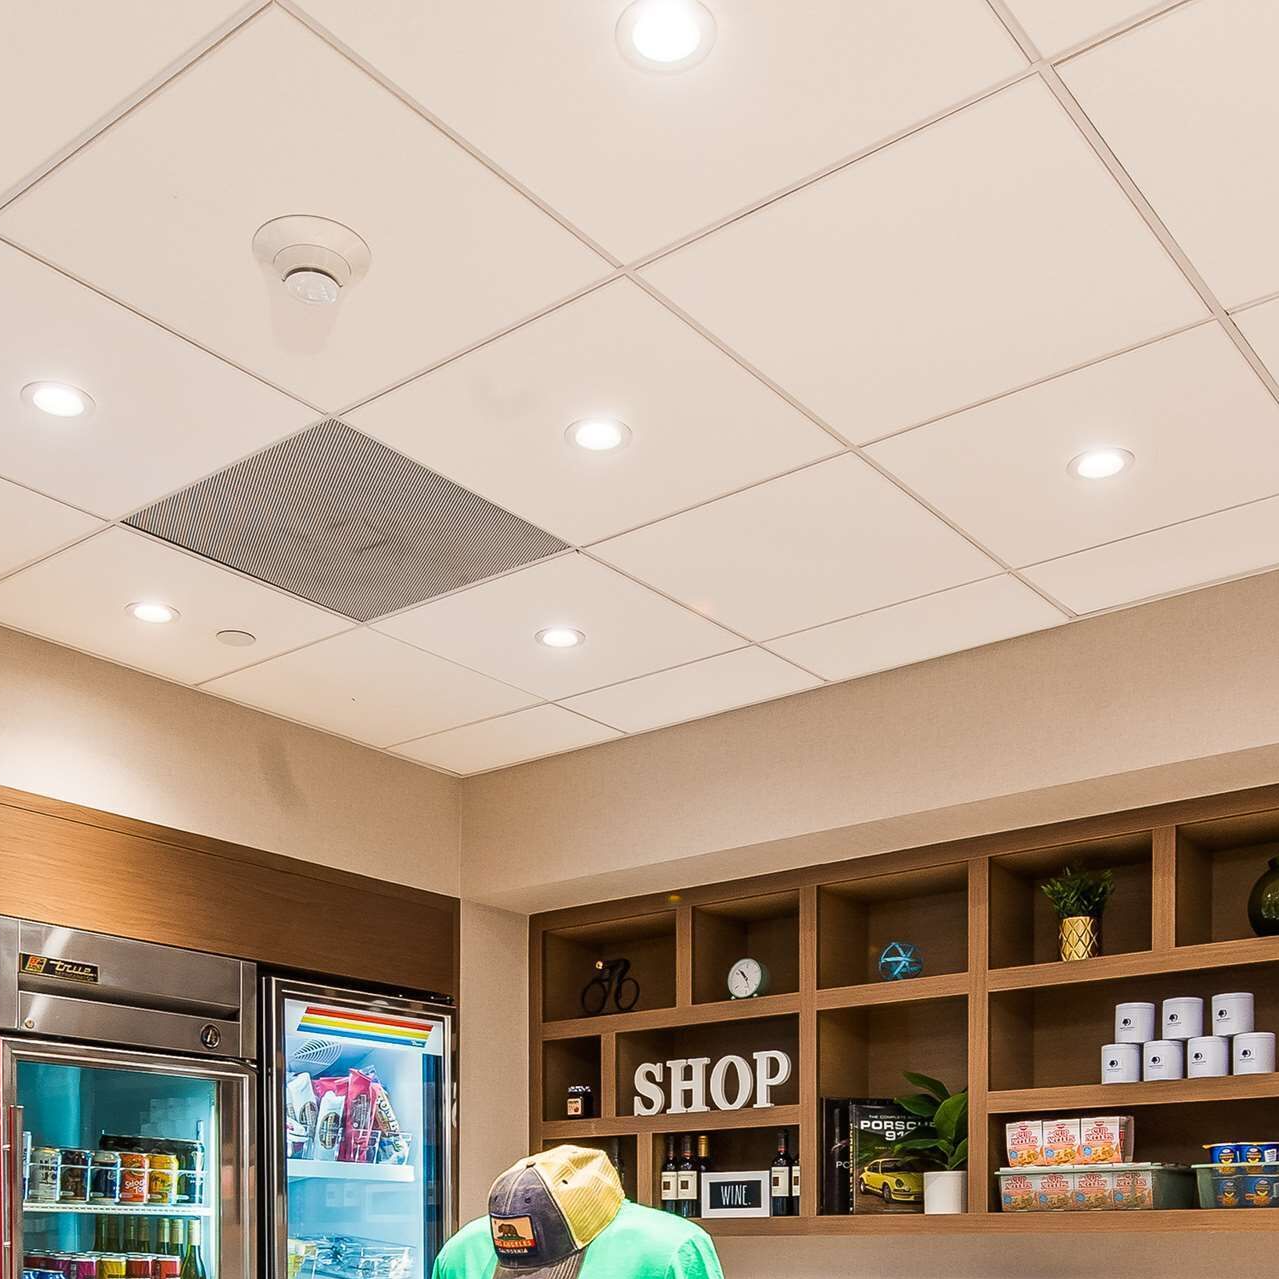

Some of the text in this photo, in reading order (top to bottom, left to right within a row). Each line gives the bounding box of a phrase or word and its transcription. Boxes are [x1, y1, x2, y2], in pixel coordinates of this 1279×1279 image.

[634, 1050, 792, 1117] SHOP
[860, 1120, 937, 1131] PORSC
[721, 1185, 751, 1206] WINE.
